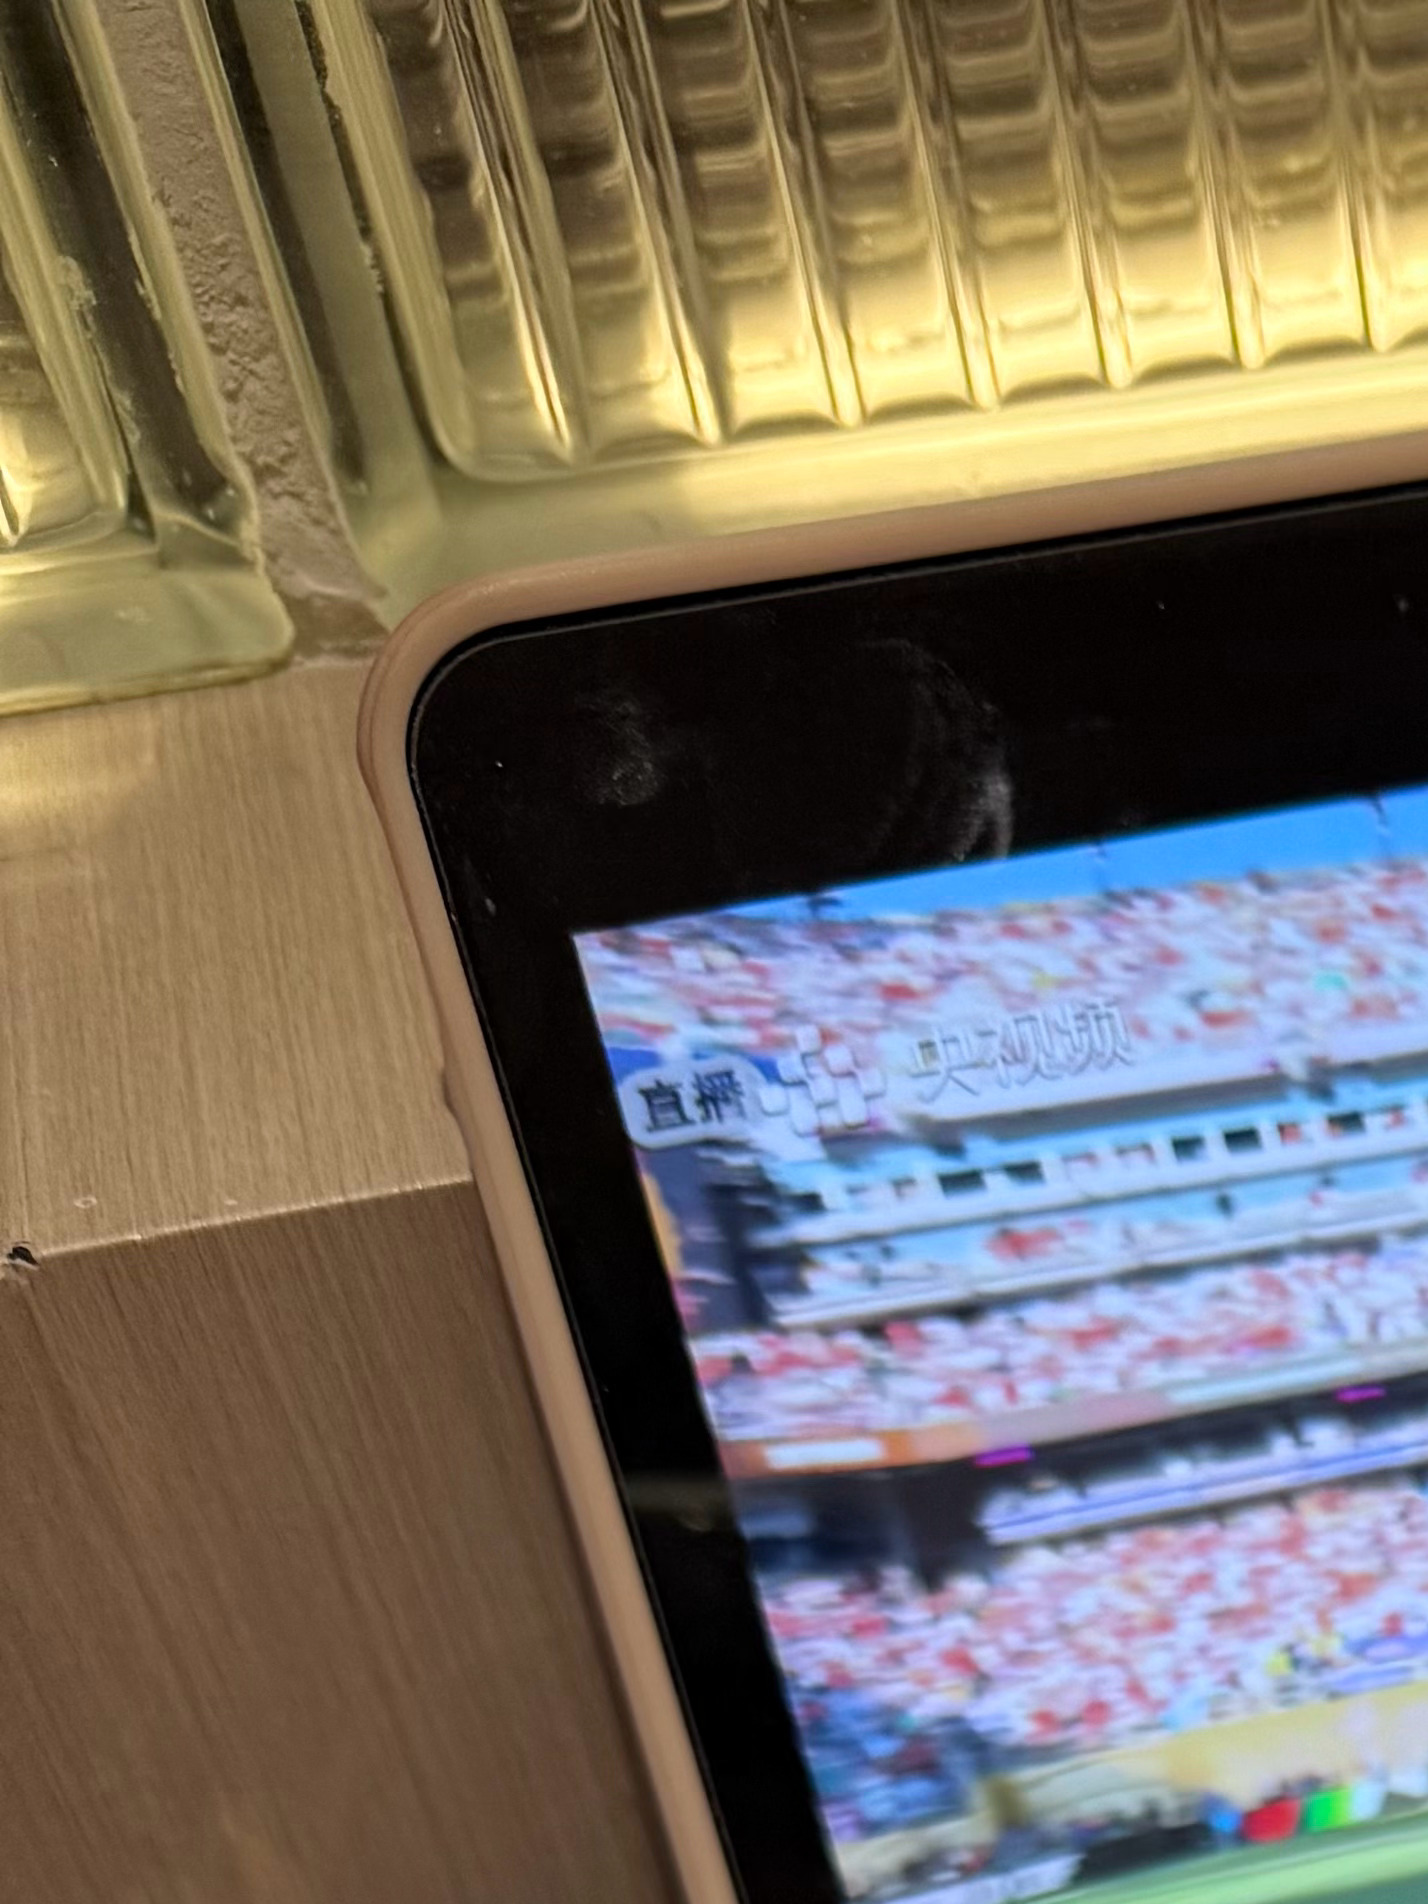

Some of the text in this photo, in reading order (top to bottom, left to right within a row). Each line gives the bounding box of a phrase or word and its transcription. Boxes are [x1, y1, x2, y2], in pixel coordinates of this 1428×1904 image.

[909, 996, 1133, 1104] 央视频
[637, 1067, 749, 1133] 直播
